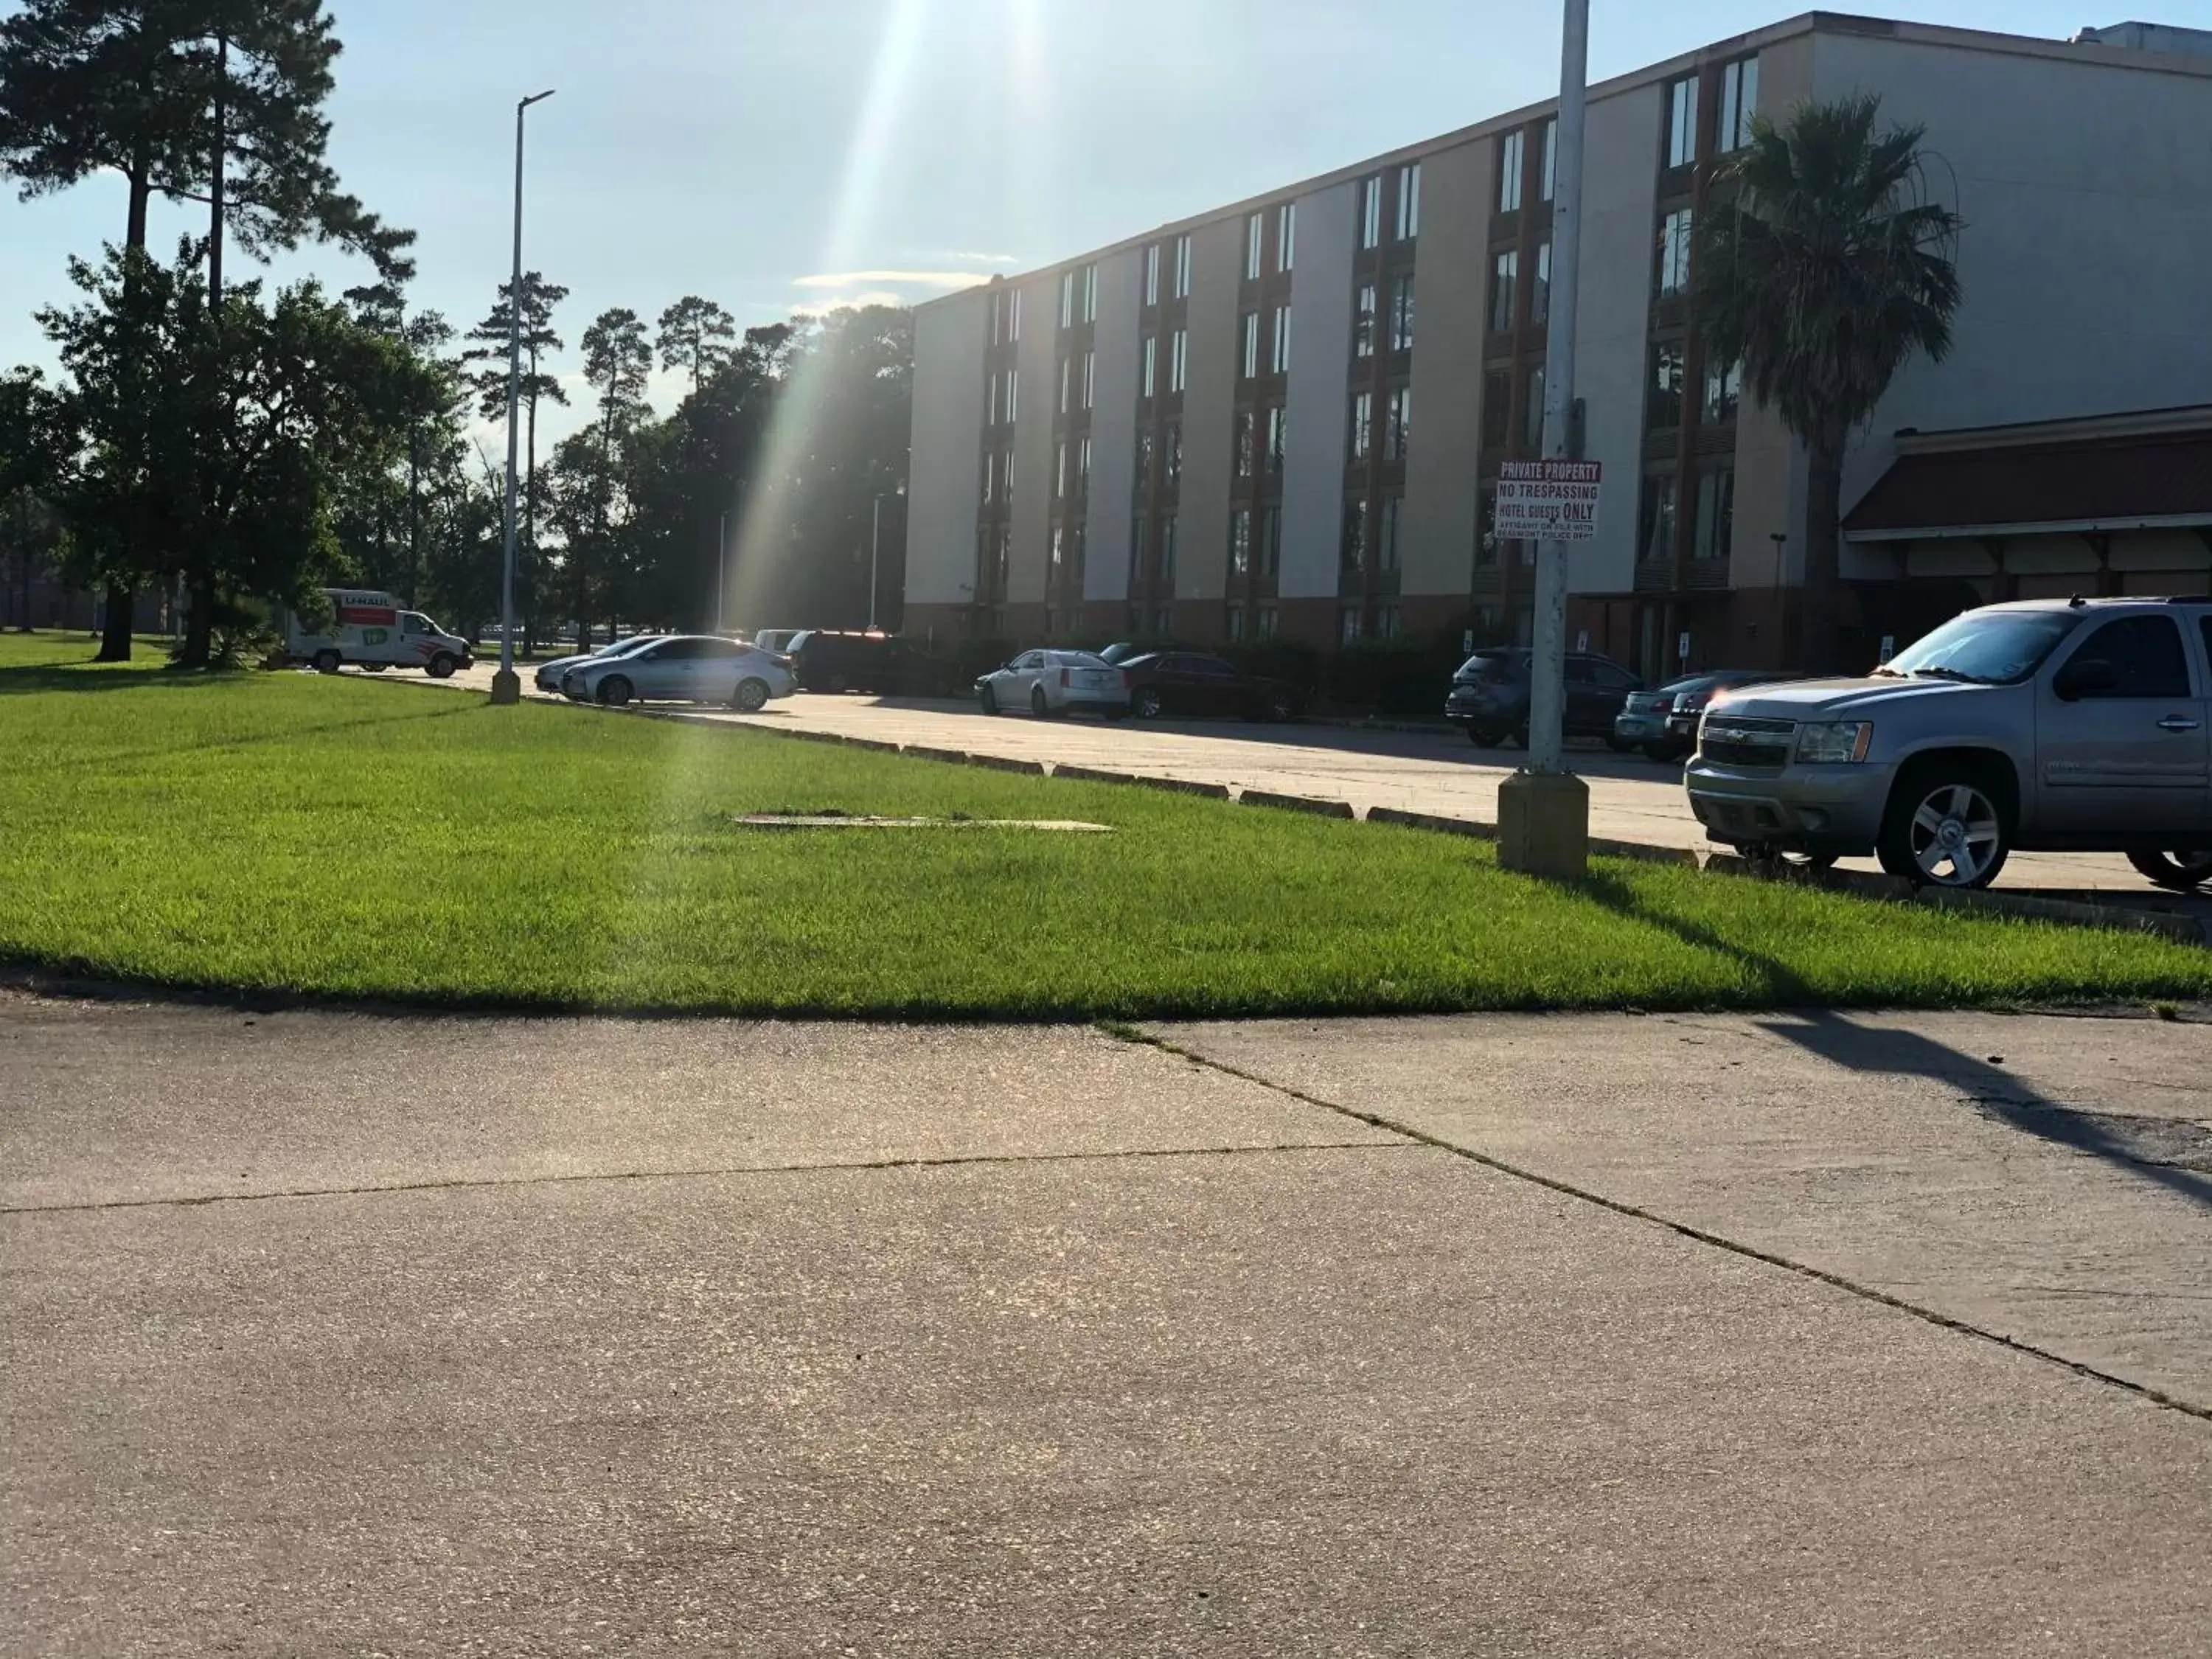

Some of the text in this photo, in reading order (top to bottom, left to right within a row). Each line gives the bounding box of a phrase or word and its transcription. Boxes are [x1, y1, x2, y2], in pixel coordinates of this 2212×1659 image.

[1501, 462, 1598, 480] PRIVATE PROPERTY
[1500, 484, 1598, 499] NO TRESPASSING
[1500, 503, 1595, 520] HOTEL GUESTS ONLY
[346, 597, 389, 606] U-HAUL
